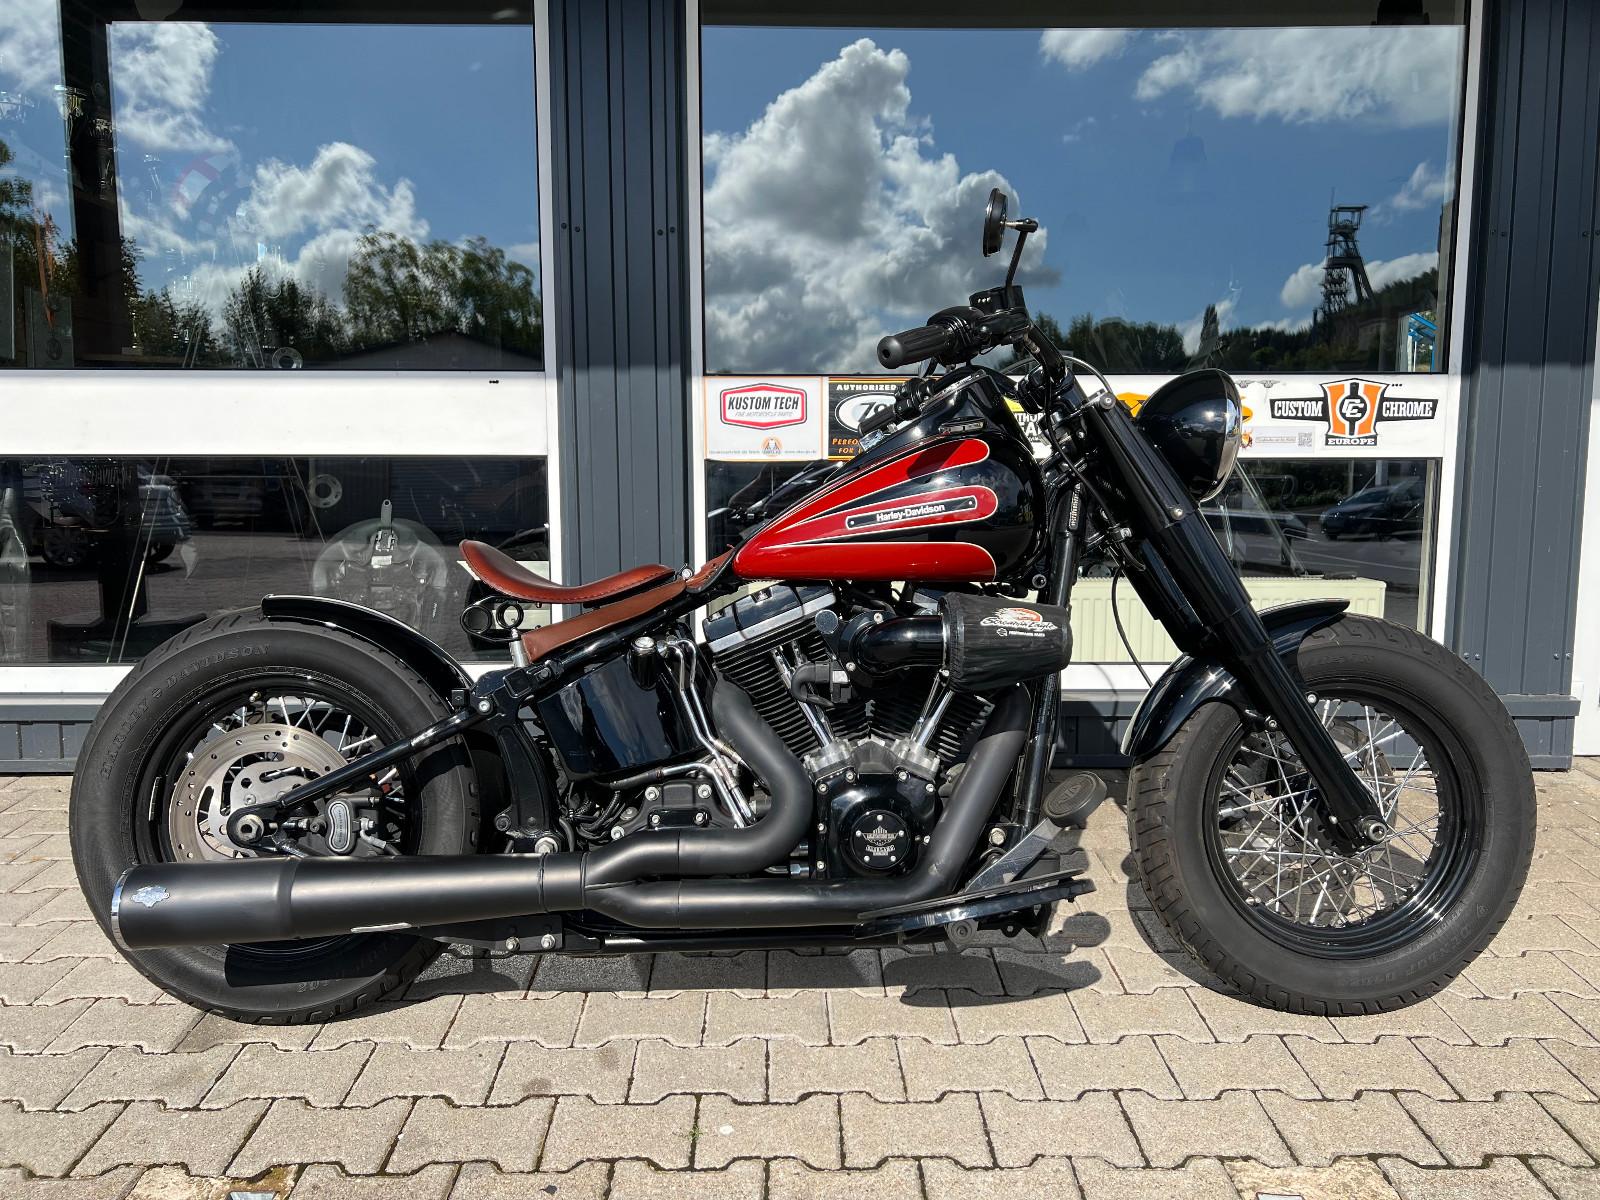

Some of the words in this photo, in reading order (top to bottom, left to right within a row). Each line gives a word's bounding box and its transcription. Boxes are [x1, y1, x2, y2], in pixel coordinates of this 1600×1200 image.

[728, 396, 771, 410] KUSTOM
[773, 396, 800, 410] TECH
[1274, 400, 1323, 418] CUSTOM
[1382, 400, 1433, 418] CHROME
[876, 504, 946, 522] Harley-Davidson
[166, 643, 272, 688] DAVIDSON
